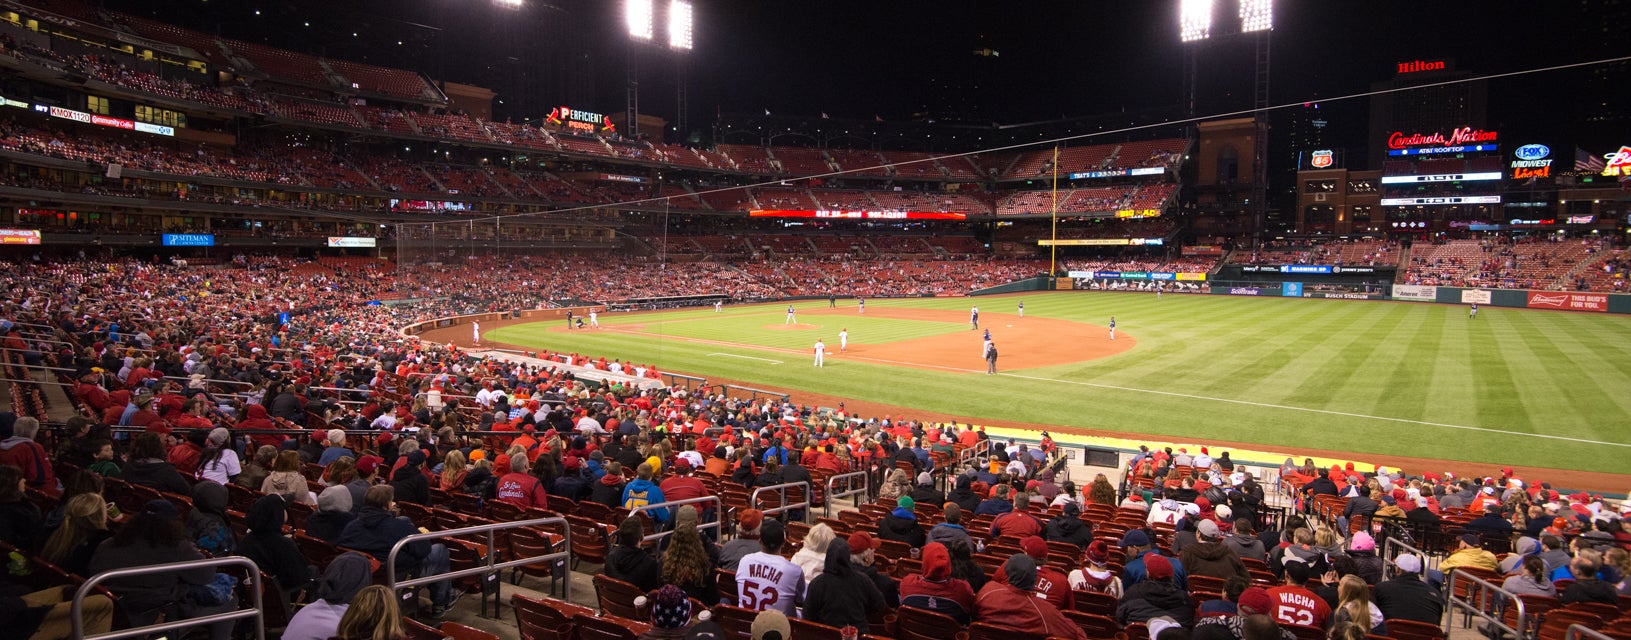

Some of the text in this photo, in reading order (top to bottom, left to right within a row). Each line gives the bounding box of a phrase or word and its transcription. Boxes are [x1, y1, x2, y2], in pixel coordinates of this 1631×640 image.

[1398, 60, 1445, 73] Hilton
[51, 107, 90, 122] KMOX1120
[560, 106, 602, 123] PERFICIENT
[120, 120, 134, 129] Coffee
[569, 121, 594, 130] PERCH
[1388, 127, 1497, 149] Cardinals Nation
[1522, 147, 1542, 156] FOX
[1315, 156, 1330, 165] 66
[1511, 159, 1553, 168] MIDWEST
[499, 486, 524, 499] Cardinals
[1165, 512, 1175, 524] 4
[749, 564, 783, 585] WACHA
[741, 579, 779, 611] 52
[1279, 592, 1315, 610] WACHA
[1278, 605, 1314, 626] 52
